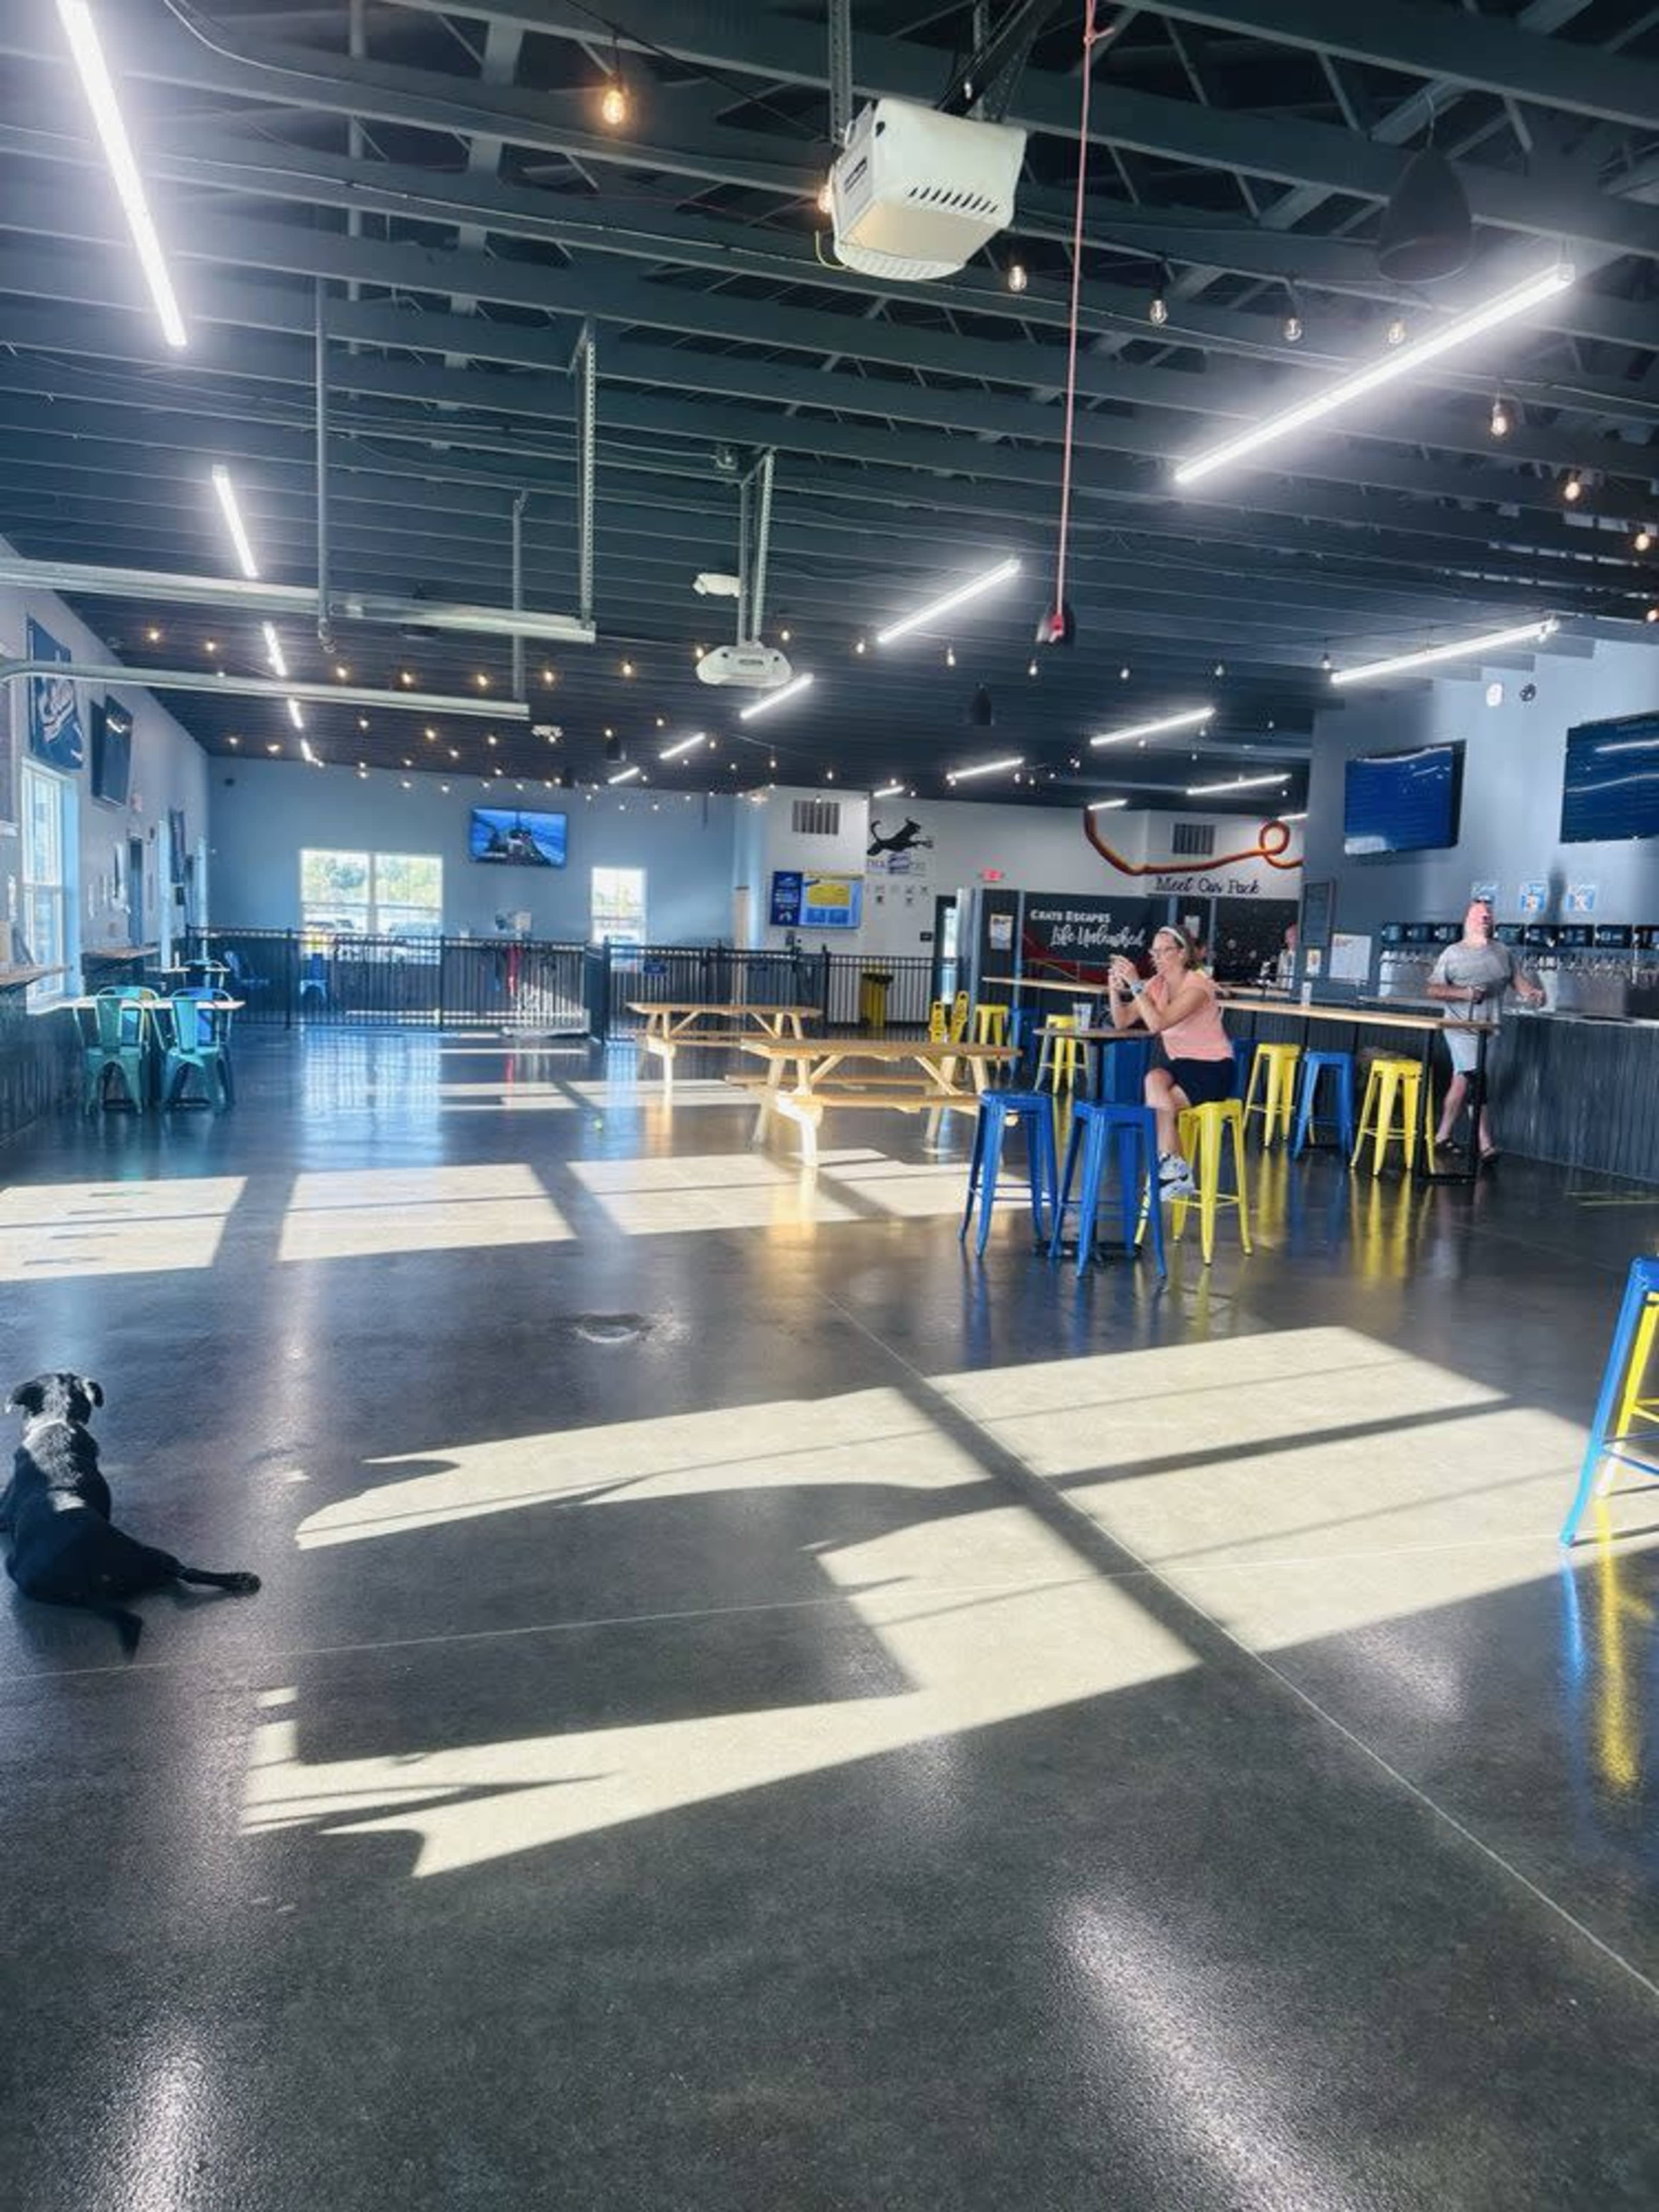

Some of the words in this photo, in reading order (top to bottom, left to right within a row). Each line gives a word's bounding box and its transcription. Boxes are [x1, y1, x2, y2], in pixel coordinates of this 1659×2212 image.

[1155, 876, 1194, 892] Meet
[1198, 877, 1222, 893] Our
[1227, 879, 1260, 894] Pack
[1050, 924, 1075, 946] Life
